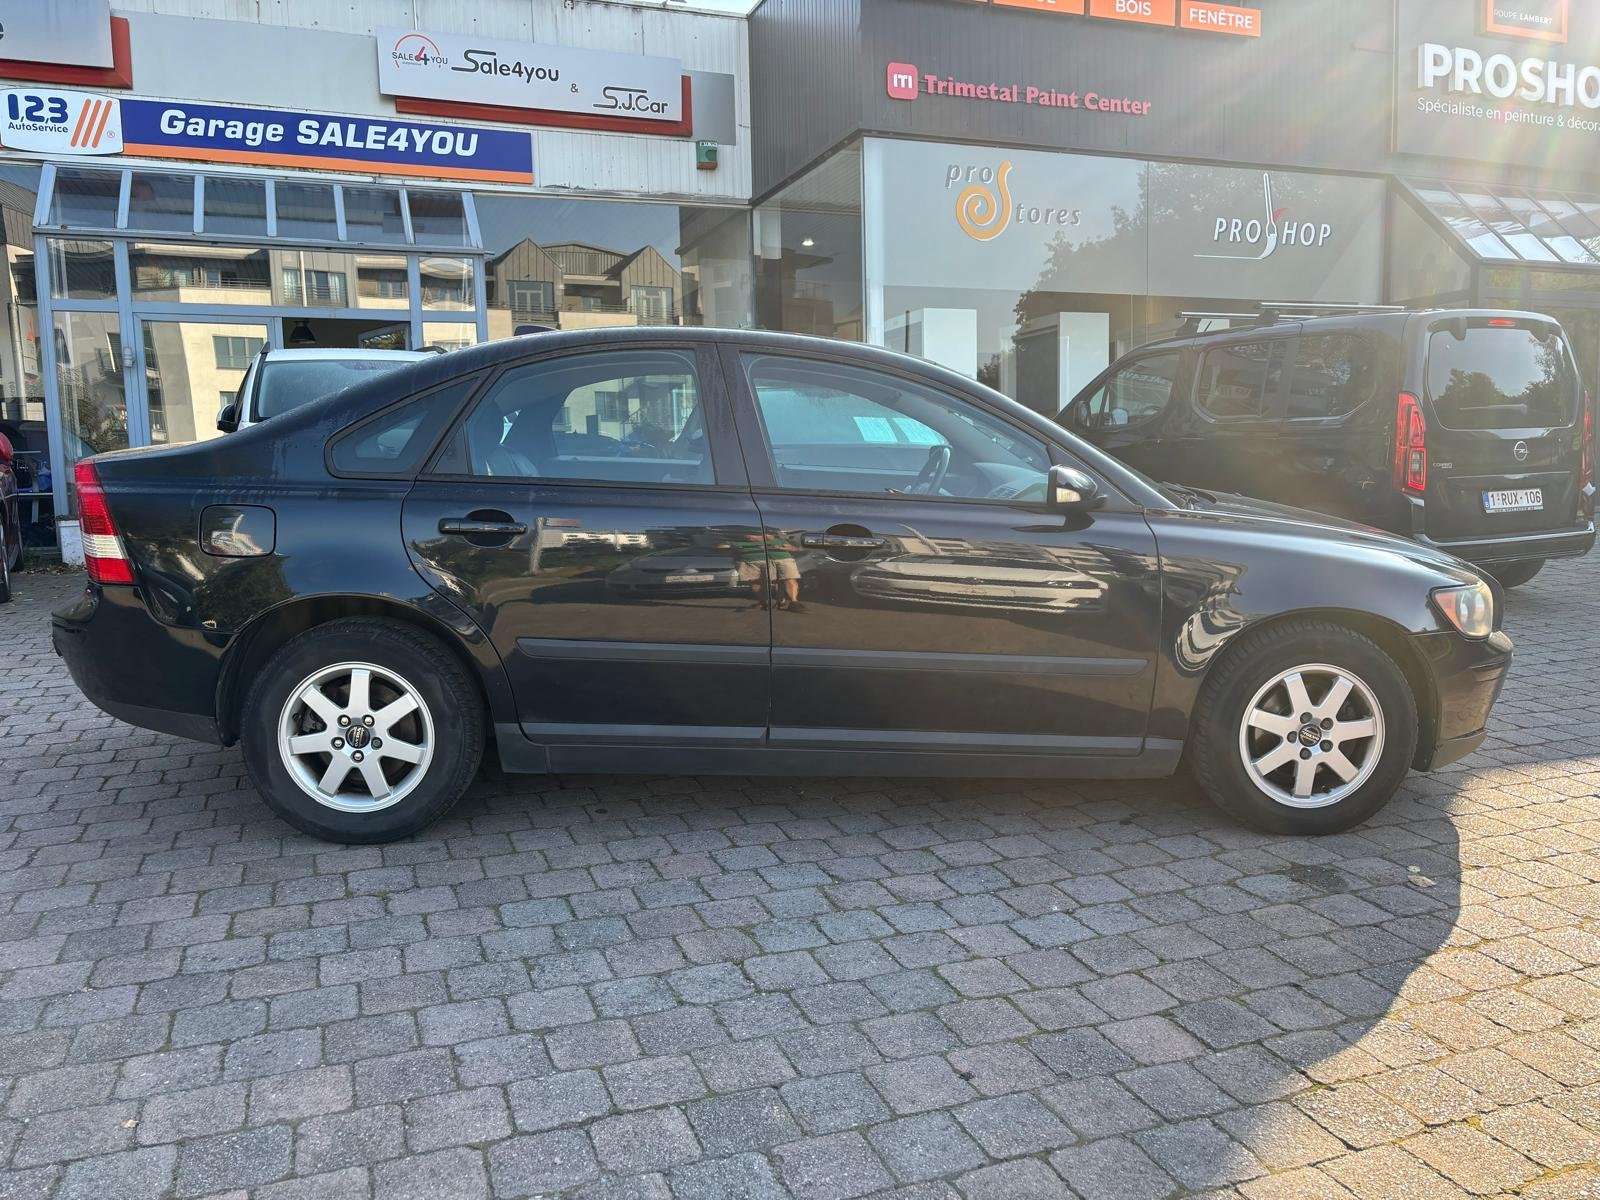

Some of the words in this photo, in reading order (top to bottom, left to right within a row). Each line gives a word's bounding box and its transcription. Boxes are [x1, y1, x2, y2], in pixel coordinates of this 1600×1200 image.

[1115, 0, 1152, 16] BOIS
[1189, 7, 1253, 29] FENÊTRE
[1519, 13, 1553, 25] LAMBERT
[451, 49, 560, 84] Sale4you
[570, 83, 579, 93] &
[924, 74, 1018, 103] Trimetal
[1026, 86, 1078, 109] Paint
[1084, 92, 1152, 115] Center
[1417, 97, 1483, 118] Spécialiste
[1486, 109, 1501, 121] en
[1504, 109, 1554, 128] peinture
[1556, 115, 1564, 128] &
[8, 121, 69, 133] AutoService
[160, 109, 284, 146] Garage
[296, 119, 479, 157] SALE4YOU
[945, 164, 995, 189] pro
